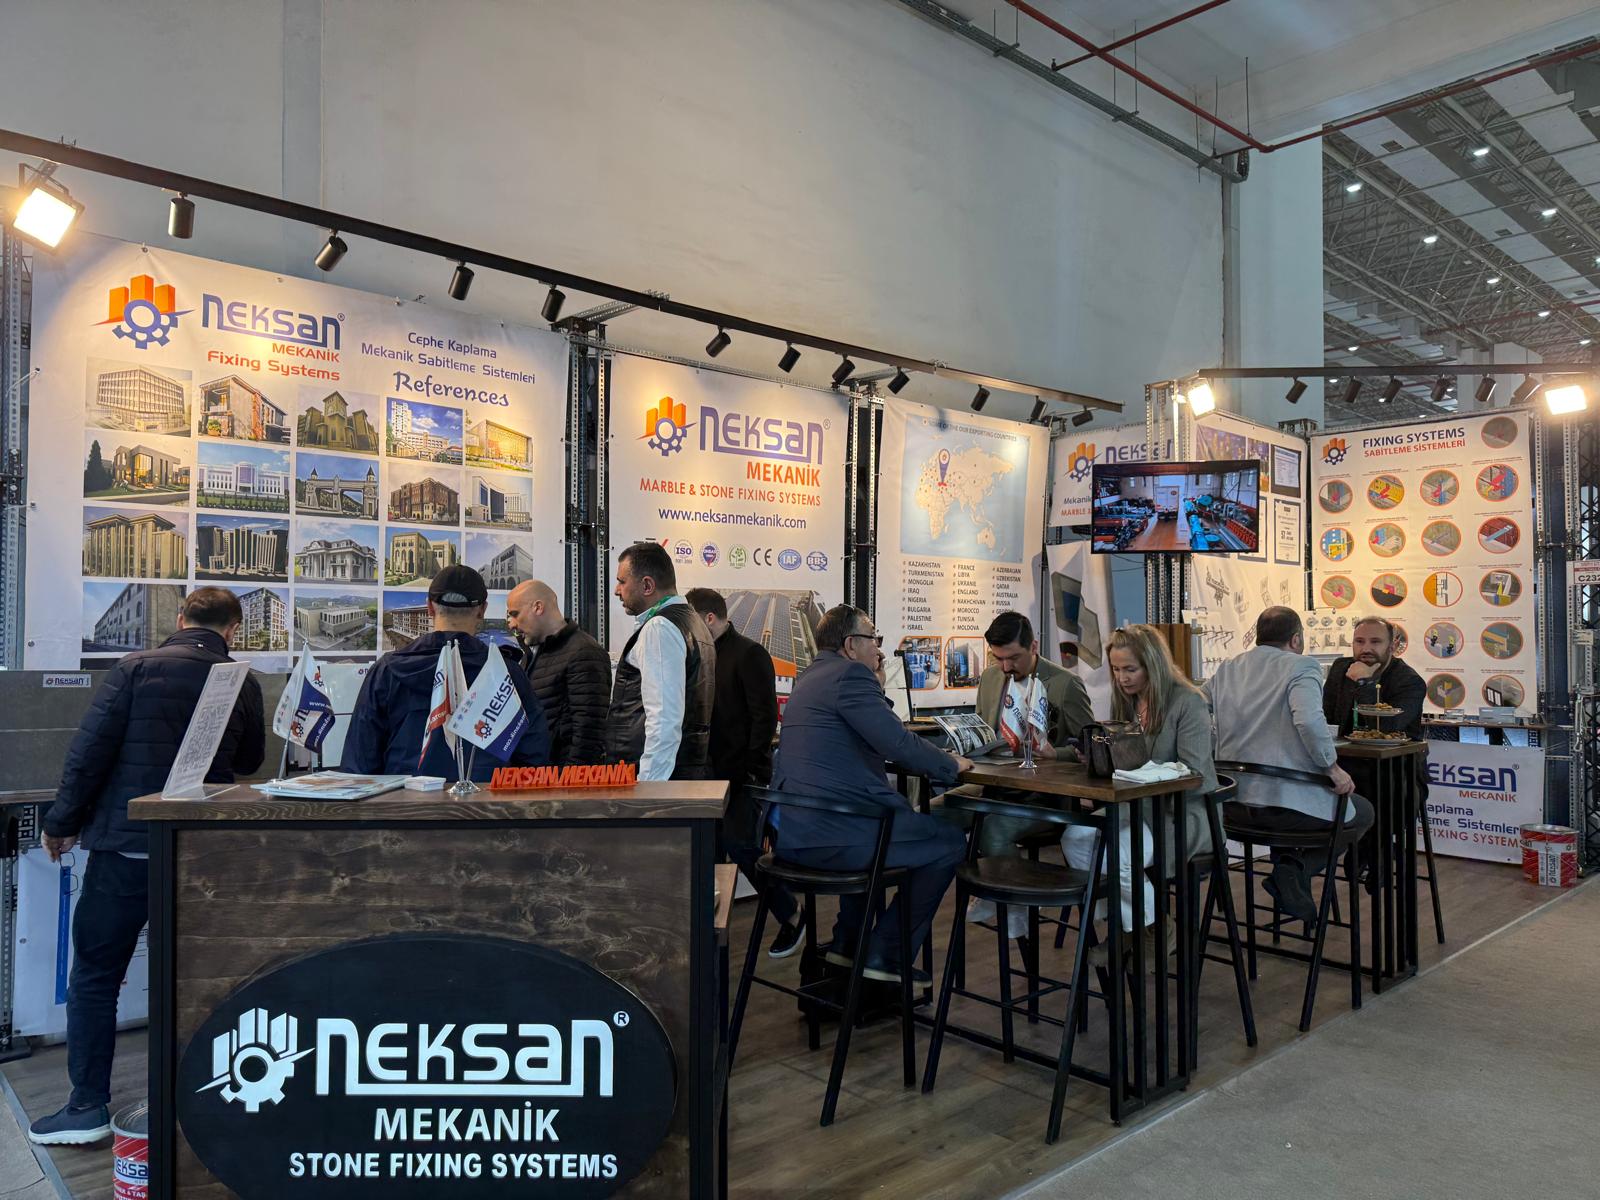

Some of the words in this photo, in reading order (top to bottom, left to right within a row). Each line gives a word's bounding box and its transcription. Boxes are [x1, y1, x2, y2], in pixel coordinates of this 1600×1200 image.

[272, 342, 340, 363] MEKANİK
[408, 332, 444, 349] Cephe
[448, 339, 497, 359] Kaplama
[207, 350, 261, 372] Fixing
[268, 359, 341, 381] Systems
[361, 342, 413, 362] Mekanik
[418, 353, 476, 373] Sabitleme
[482, 364, 536, 385] Sistemleri
[393, 370, 510, 408] References
[1362, 434, 1404, 449] FIXING
[1406, 427, 1466, 444] SYSTEMS
[1364, 444, 1412, 458] SABİTLEME
[1413, 439, 1466, 453] SİSTEMLERİ
[746, 461, 821, 487] MEKANİK
[639, 478, 686, 495] MARBLE
[689, 485, 696, 496] &
[700, 484, 734, 499] STONE
[738, 487, 775, 503] FIXING
[779, 491, 821, 507] SYSTEMS
[658, 507, 807, 529] www.neksanmekanik.com
[676, 547, 692, 555] ISO
[783, 555, 797, 565] IAF
[807, 556, 827, 566] BBS
[908, 569, 945, 577] TURKMENISTAN
[908, 578, 934, 586] MONGOLIA
[957, 588, 979, 596] ENGLAND
[490, 766, 559, 788] NEKSAN
[558, 760, 636, 785] MEKANİK
[1459, 790, 1517, 803] MEKANİK
[1426, 803, 1473, 816] aplama
[1458, 818, 1519, 834] Sistemler
[1473, 833, 1518, 848] SYSTEM
[374, 1101, 560, 1142] MEKANİK
[289, 1152, 379, 1179] STONE
[390, 1152, 483, 1179] FIXING
[491, 1152, 618, 1179] SYSTEMS
